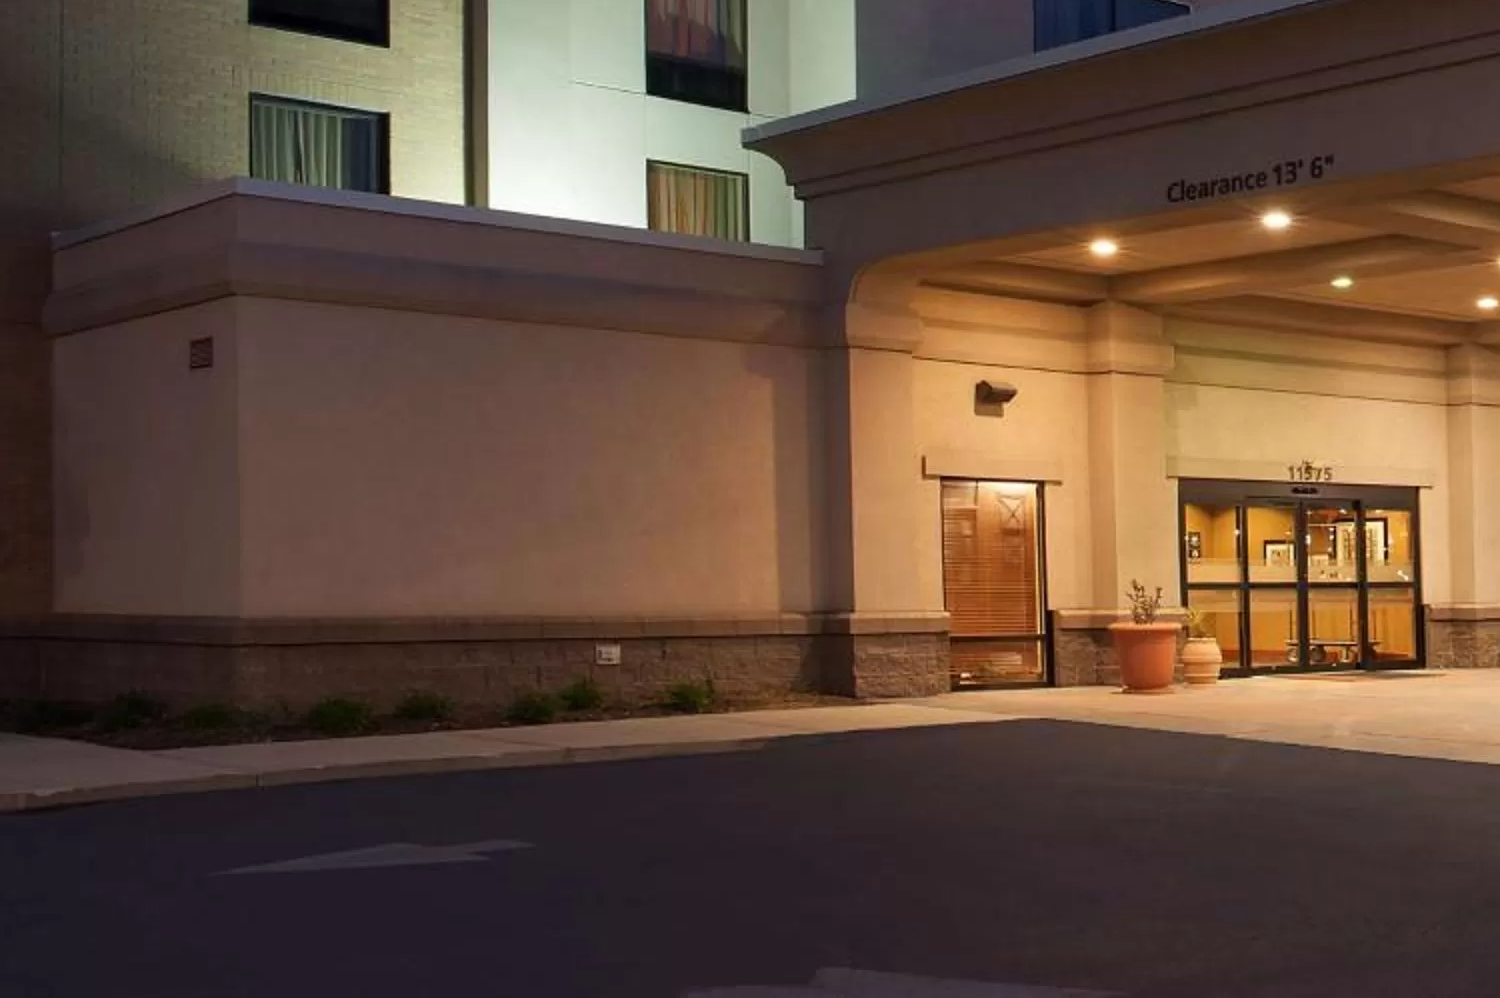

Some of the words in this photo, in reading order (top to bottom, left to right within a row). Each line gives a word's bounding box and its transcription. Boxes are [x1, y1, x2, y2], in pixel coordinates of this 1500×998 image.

[1167, 170, 1268, 203] Clearance
[1272, 159, 1304, 186] 13'
[1310, 154, 1335, 179] 6"
[1287, 465, 1333, 481] 11575
